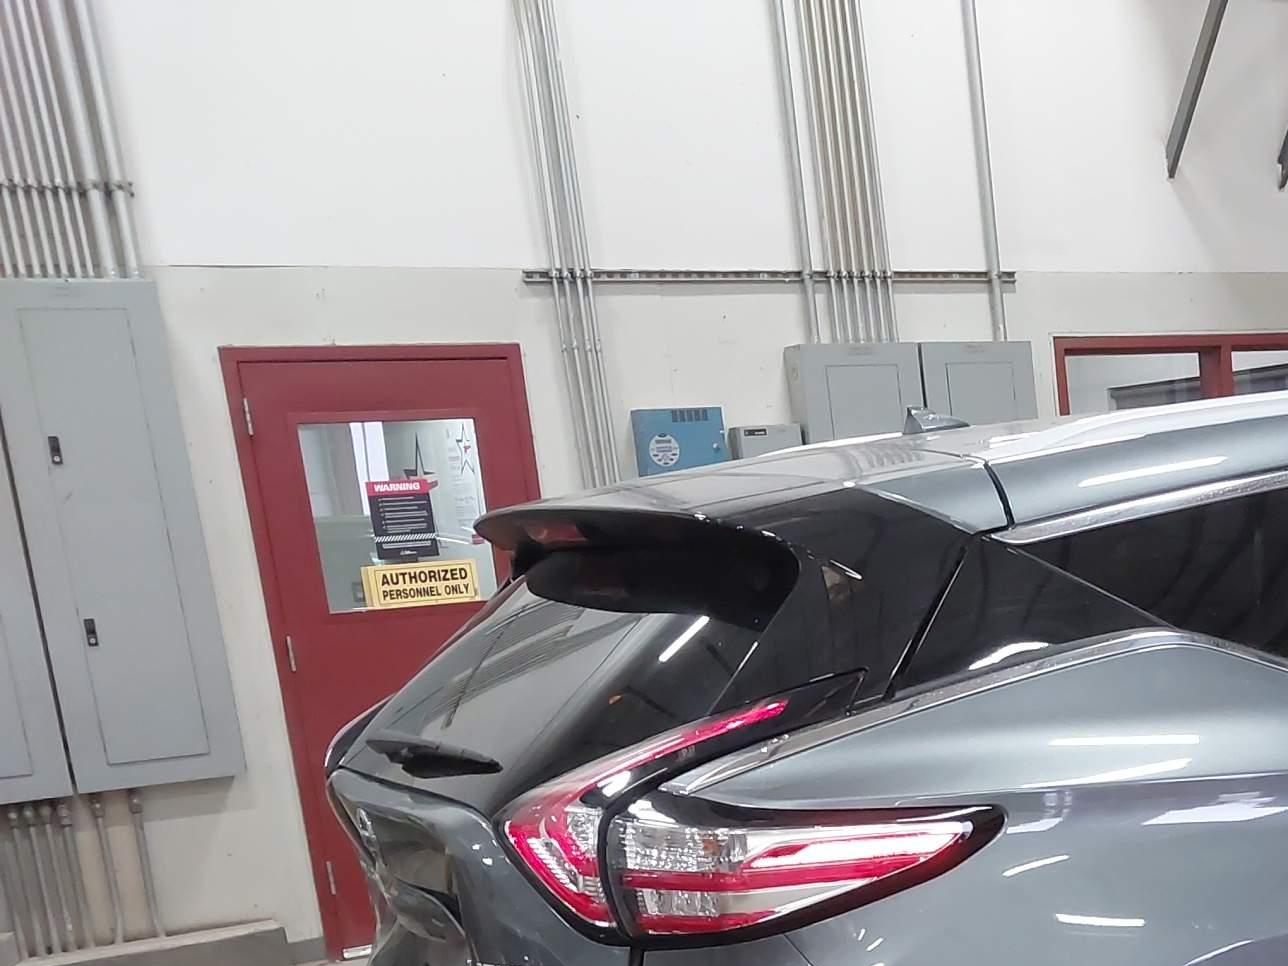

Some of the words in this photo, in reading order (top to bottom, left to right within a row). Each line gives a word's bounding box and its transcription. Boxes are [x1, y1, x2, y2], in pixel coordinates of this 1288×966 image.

[373, 482, 421, 492] WARNING
[381, 567, 469, 587] AUTHORIZED
[382, 586, 443, 601] PERSONNEL
[444, 583, 470, 596] ONLY
